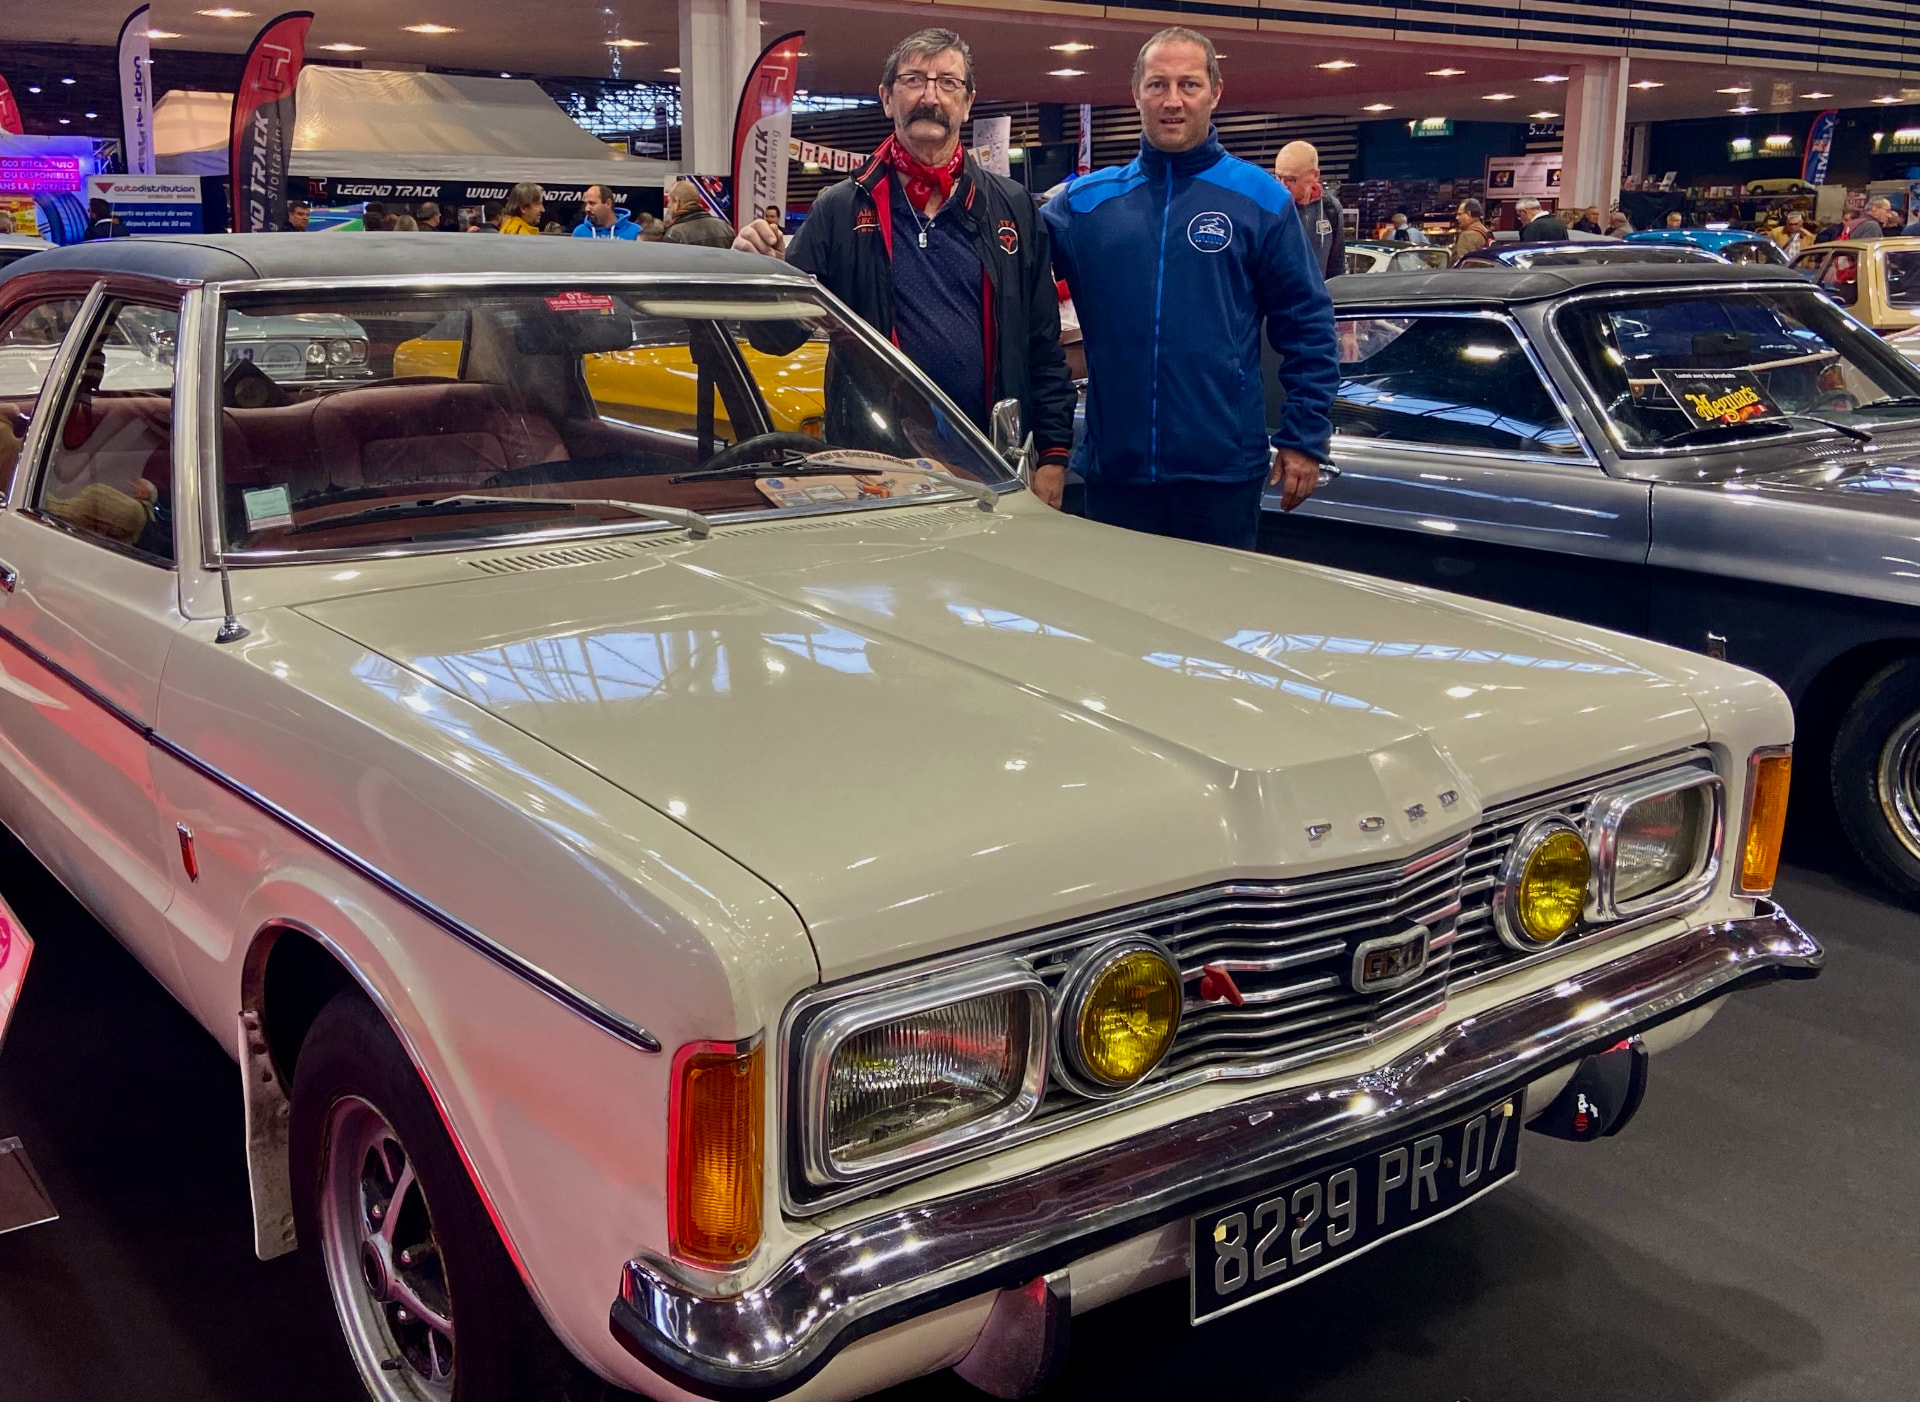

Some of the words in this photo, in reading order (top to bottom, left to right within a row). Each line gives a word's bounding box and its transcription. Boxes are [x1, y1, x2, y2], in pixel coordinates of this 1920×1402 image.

[1528, 123, 1555, 135] 5.22
[250, 110, 268, 195] TRACK
[754, 125, 768, 198] TRACK
[114, 184, 195, 193] autodistribution
[336, 184, 392, 196] LEGEND
[395, 186, 441, 198] TRACK
[1305, 790, 1459, 841] FORD
[1364, 941, 1422, 980] GXL
[1214, 1168, 1357, 1295] 8229
[1377, 1135, 1442, 1225] PR
[1459, 1098, 1512, 1187] 07
